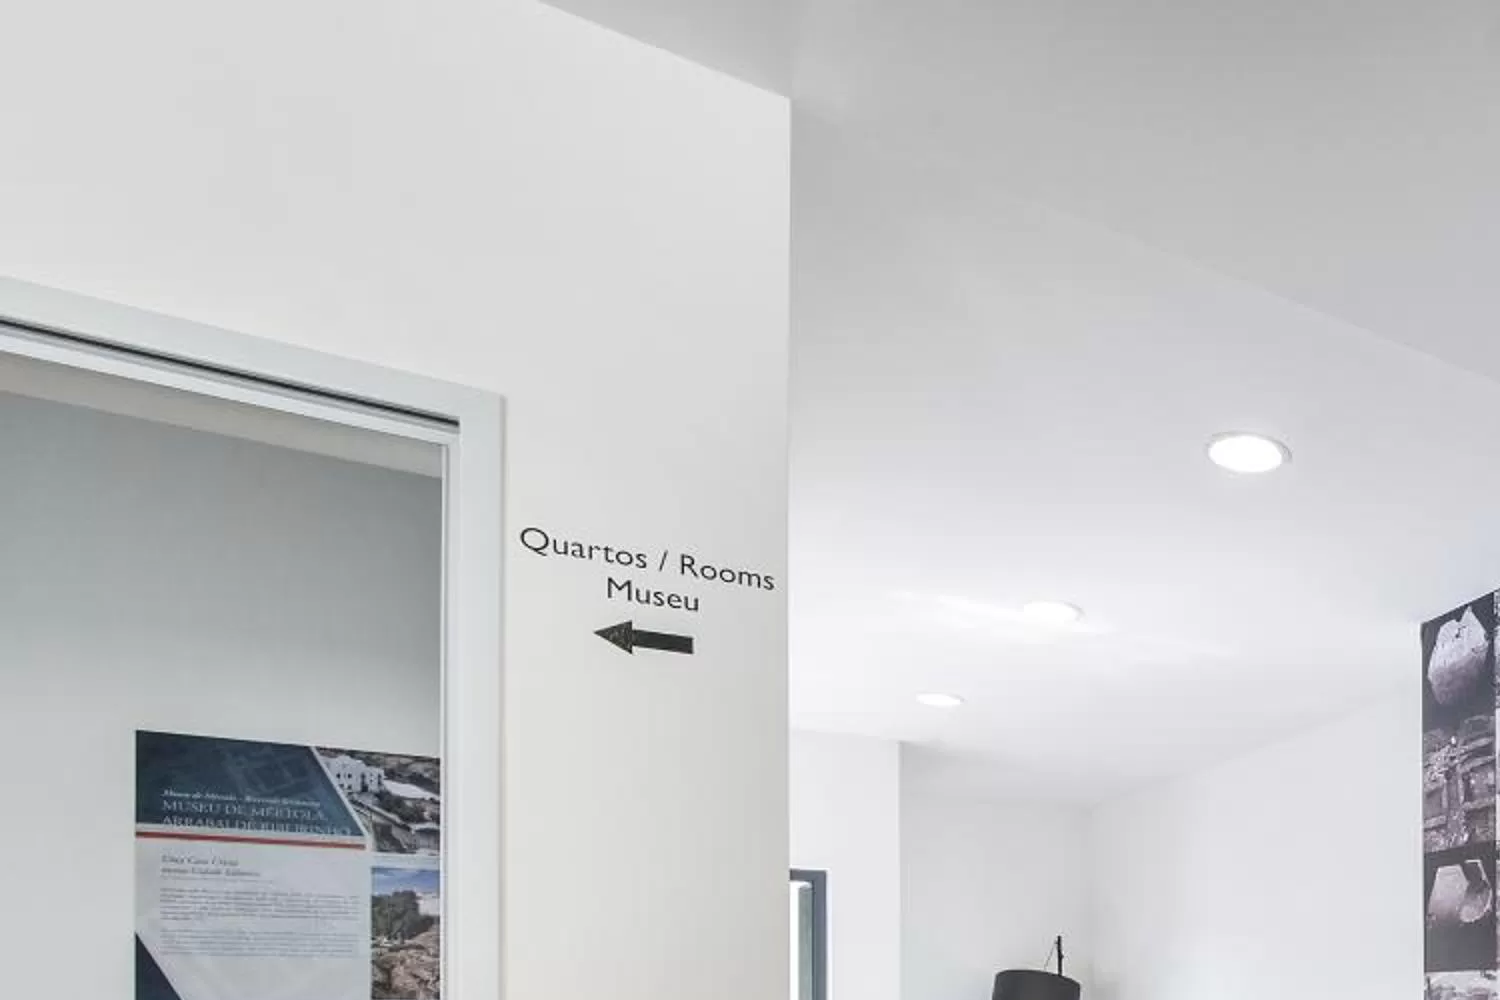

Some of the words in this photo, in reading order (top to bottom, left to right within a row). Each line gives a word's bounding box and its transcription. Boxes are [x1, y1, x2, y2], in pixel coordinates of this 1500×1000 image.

[520, 528, 647, 568] Quartos
[659, 550, 668, 572] /
[680, 554, 775, 591] Rooms
[608, 577, 699, 612] Museu
[161, 799, 220, 814] MUSEU
[225, 804, 247, 815] DE
